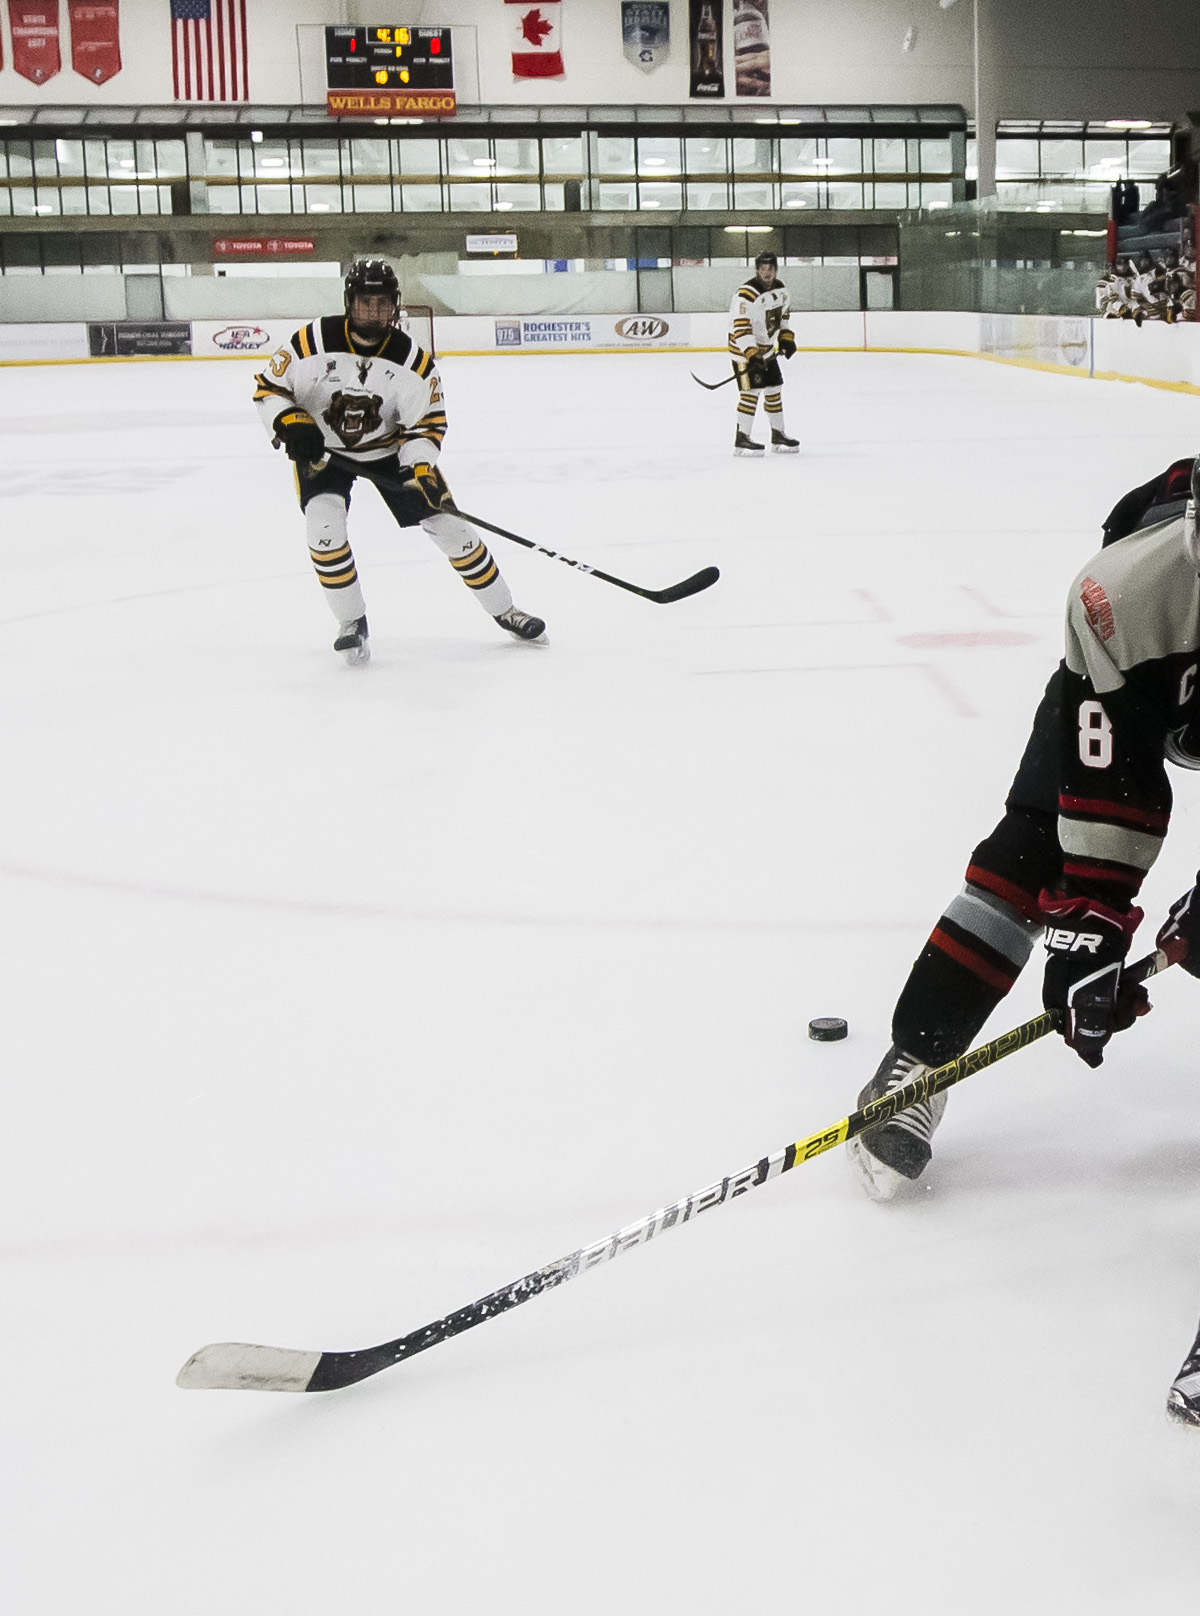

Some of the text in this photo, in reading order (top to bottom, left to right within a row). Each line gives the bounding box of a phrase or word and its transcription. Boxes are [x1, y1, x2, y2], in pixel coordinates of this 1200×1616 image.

[329, 96, 455, 109] WELLS FARGO
[284, 241, 314, 249] TOYOTA
[524, 322, 591, 332] ROCHESTER'S
[524, 332, 592, 342] GREATEST HITS
[1078, 700, 1112, 769] 8
[853, 1010, 1054, 1136] SUPREM
